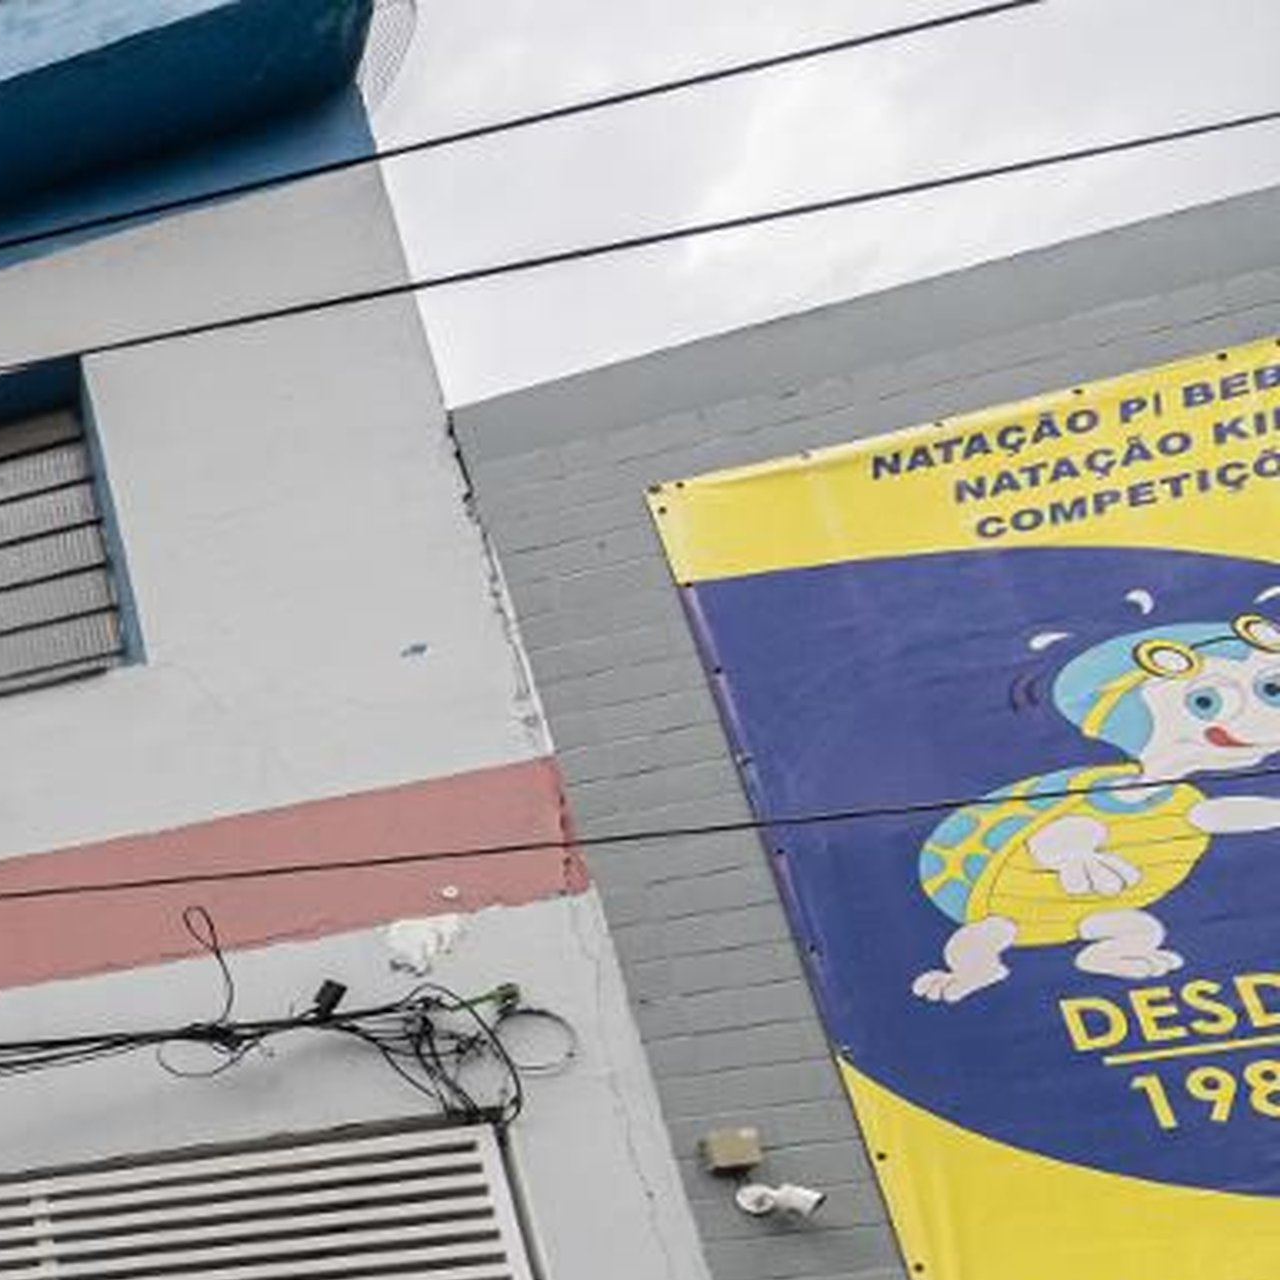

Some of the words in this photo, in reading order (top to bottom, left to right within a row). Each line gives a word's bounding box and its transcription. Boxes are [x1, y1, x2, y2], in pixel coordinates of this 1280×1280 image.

[871, 409, 1100, 480] NATAÇÃO
[953, 431, 1192, 503] NATAÇÃO
[1213, 405, 1280, 444] KI
[1059, 973, 1280, 1051] DESD
[1130, 1059, 1280, 1130] 198
